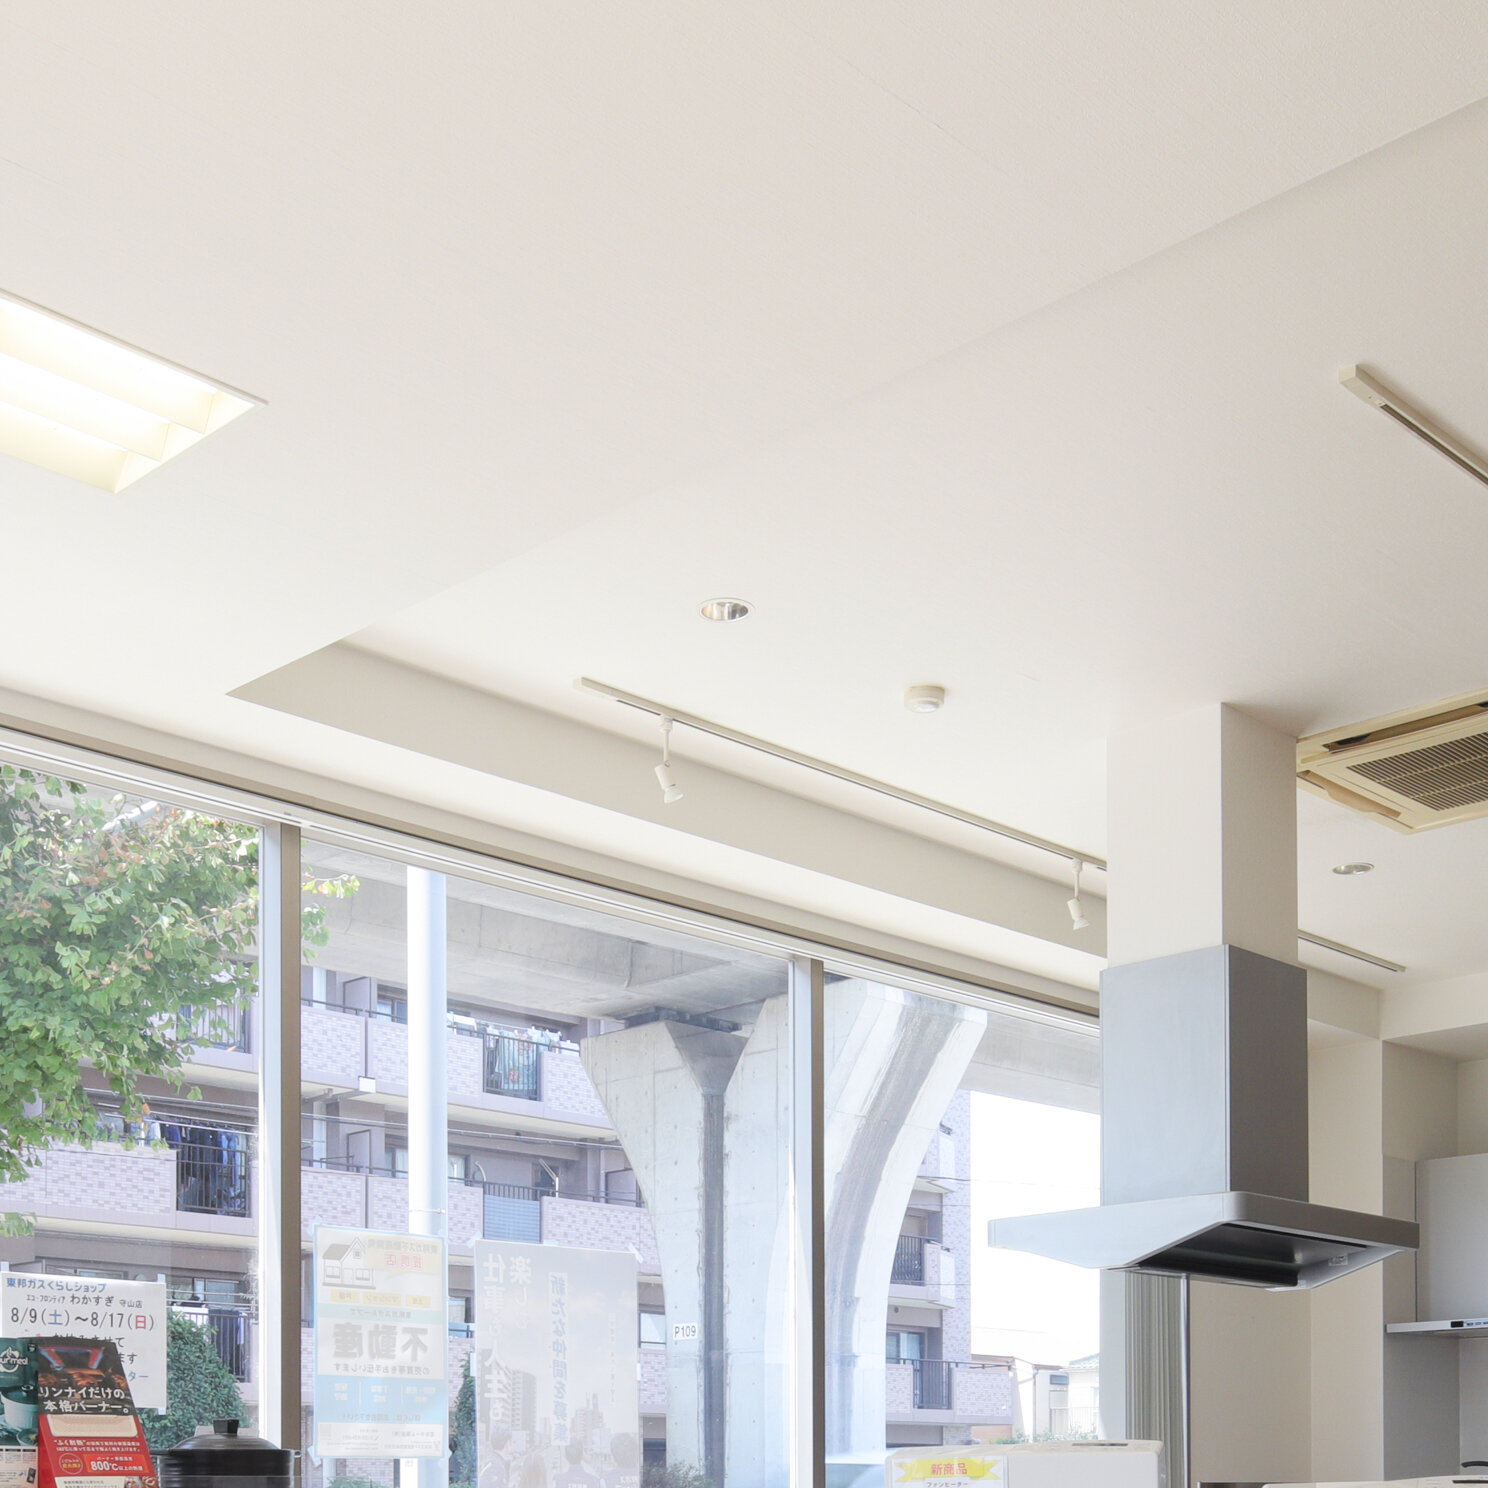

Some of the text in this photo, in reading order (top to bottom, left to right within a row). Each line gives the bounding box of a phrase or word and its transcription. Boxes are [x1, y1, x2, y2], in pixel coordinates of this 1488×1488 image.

[6, 1277, 108, 1293] 東邦ガスくらしショップ
[70, 1294, 115, 1307] わかすぎ
[118, 1299, 143, 1309] 守山店
[673, 1325, 697, 1338] P109
[39, 1386, 125, 1400] リンナイだけの
[43, 1400, 130, 1414] 本格バーナー。
[931, 1462, 967, 1476] 新商品
